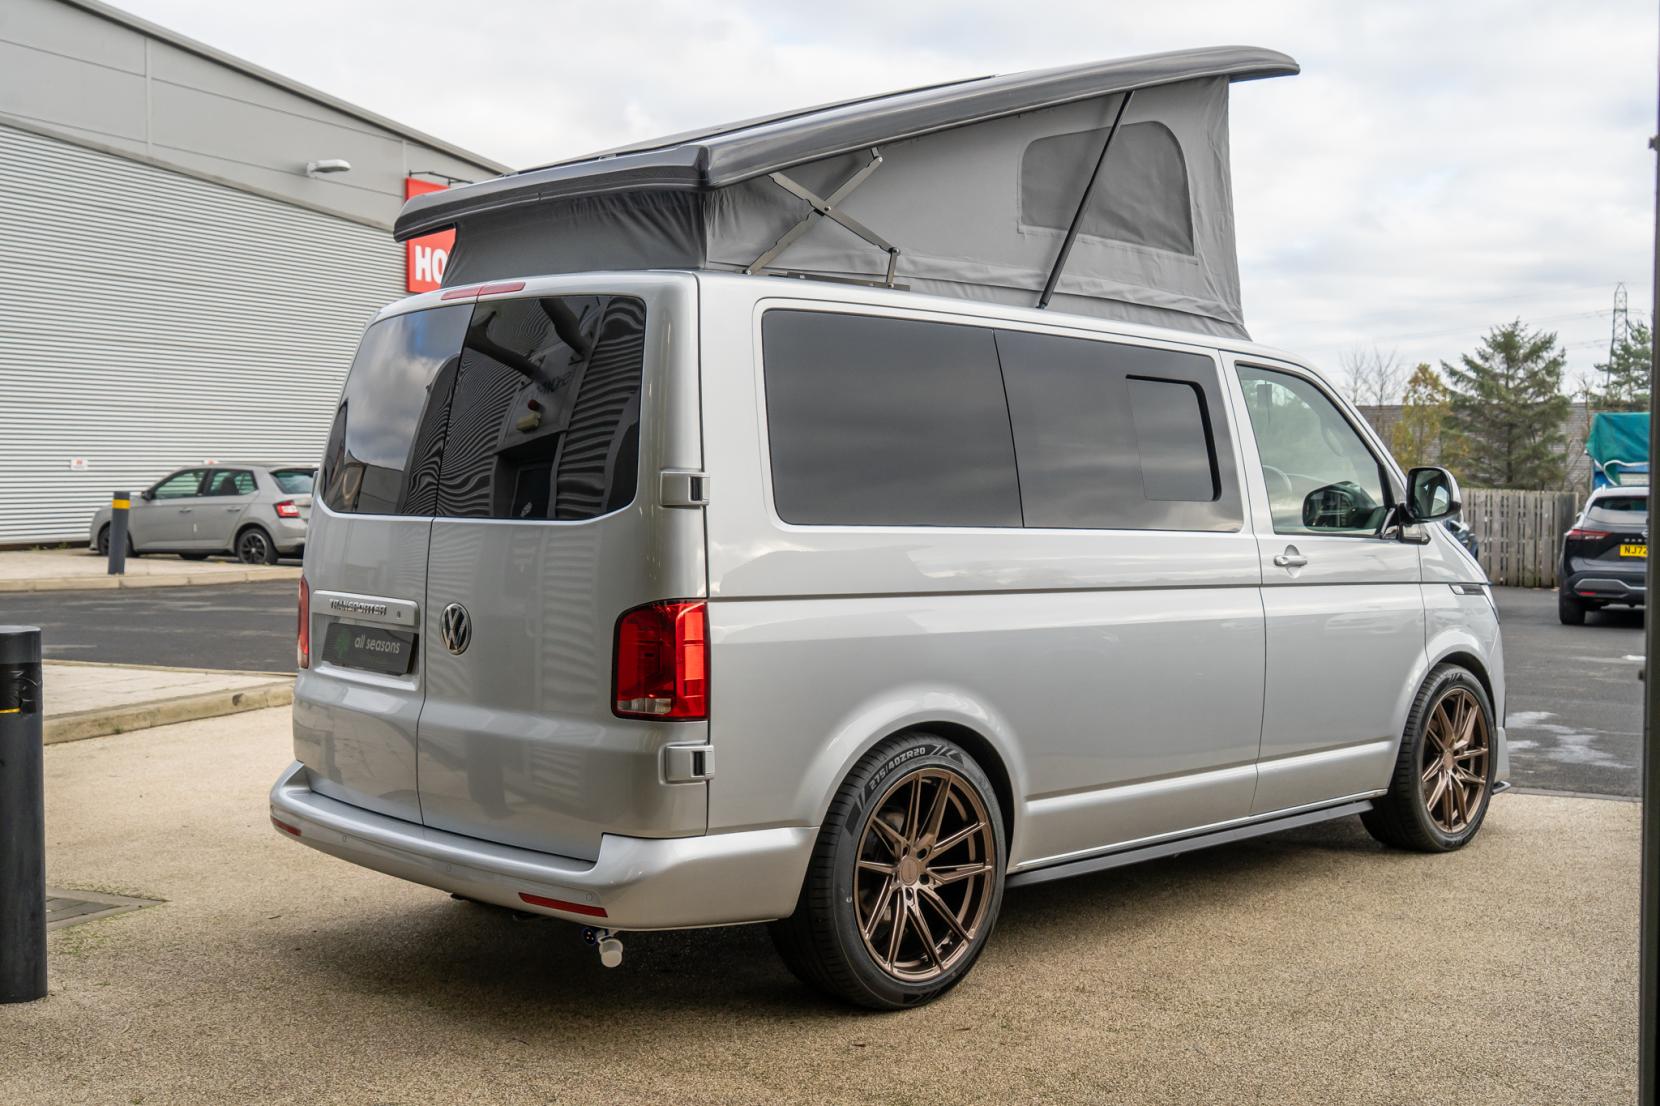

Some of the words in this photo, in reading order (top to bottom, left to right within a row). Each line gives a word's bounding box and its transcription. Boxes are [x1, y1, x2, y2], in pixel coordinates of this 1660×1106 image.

[415, 245, 450, 285] HO
[354, 635, 364, 649] all
[365, 639, 400, 654] seasons
[868, 747, 926, 791] 275/40ZR20
